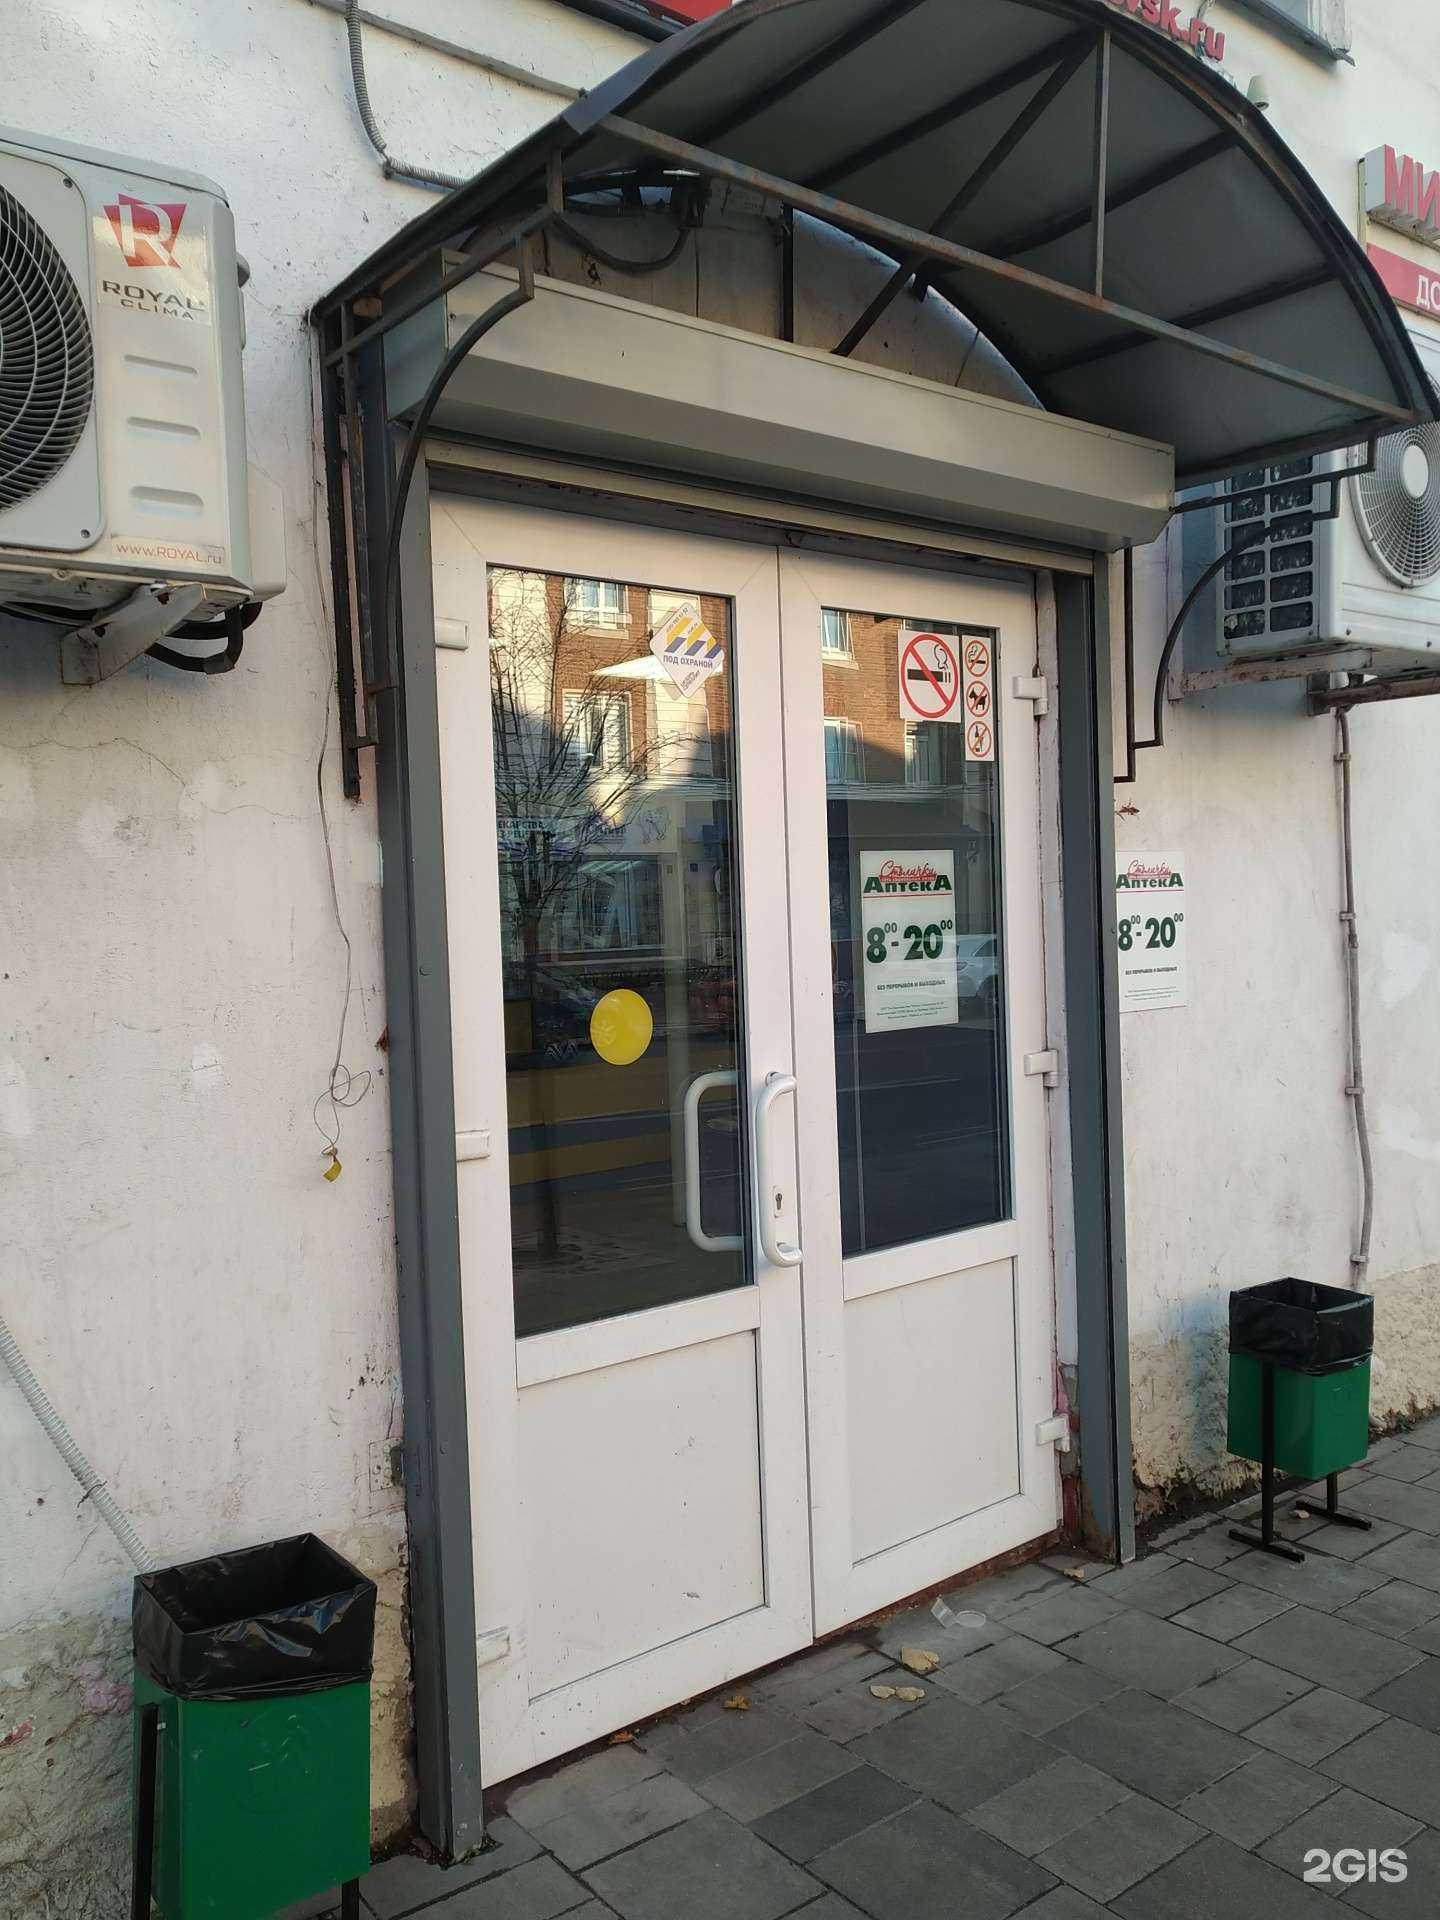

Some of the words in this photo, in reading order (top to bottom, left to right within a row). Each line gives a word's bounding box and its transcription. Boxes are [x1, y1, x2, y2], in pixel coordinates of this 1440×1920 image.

[102, 280, 205, 311] ROYAL
[120, 299, 194, 320] CLIMA
[663, 655, 679, 665] ПОД
[680, 657, 713, 668] ОХРАНОЙ
